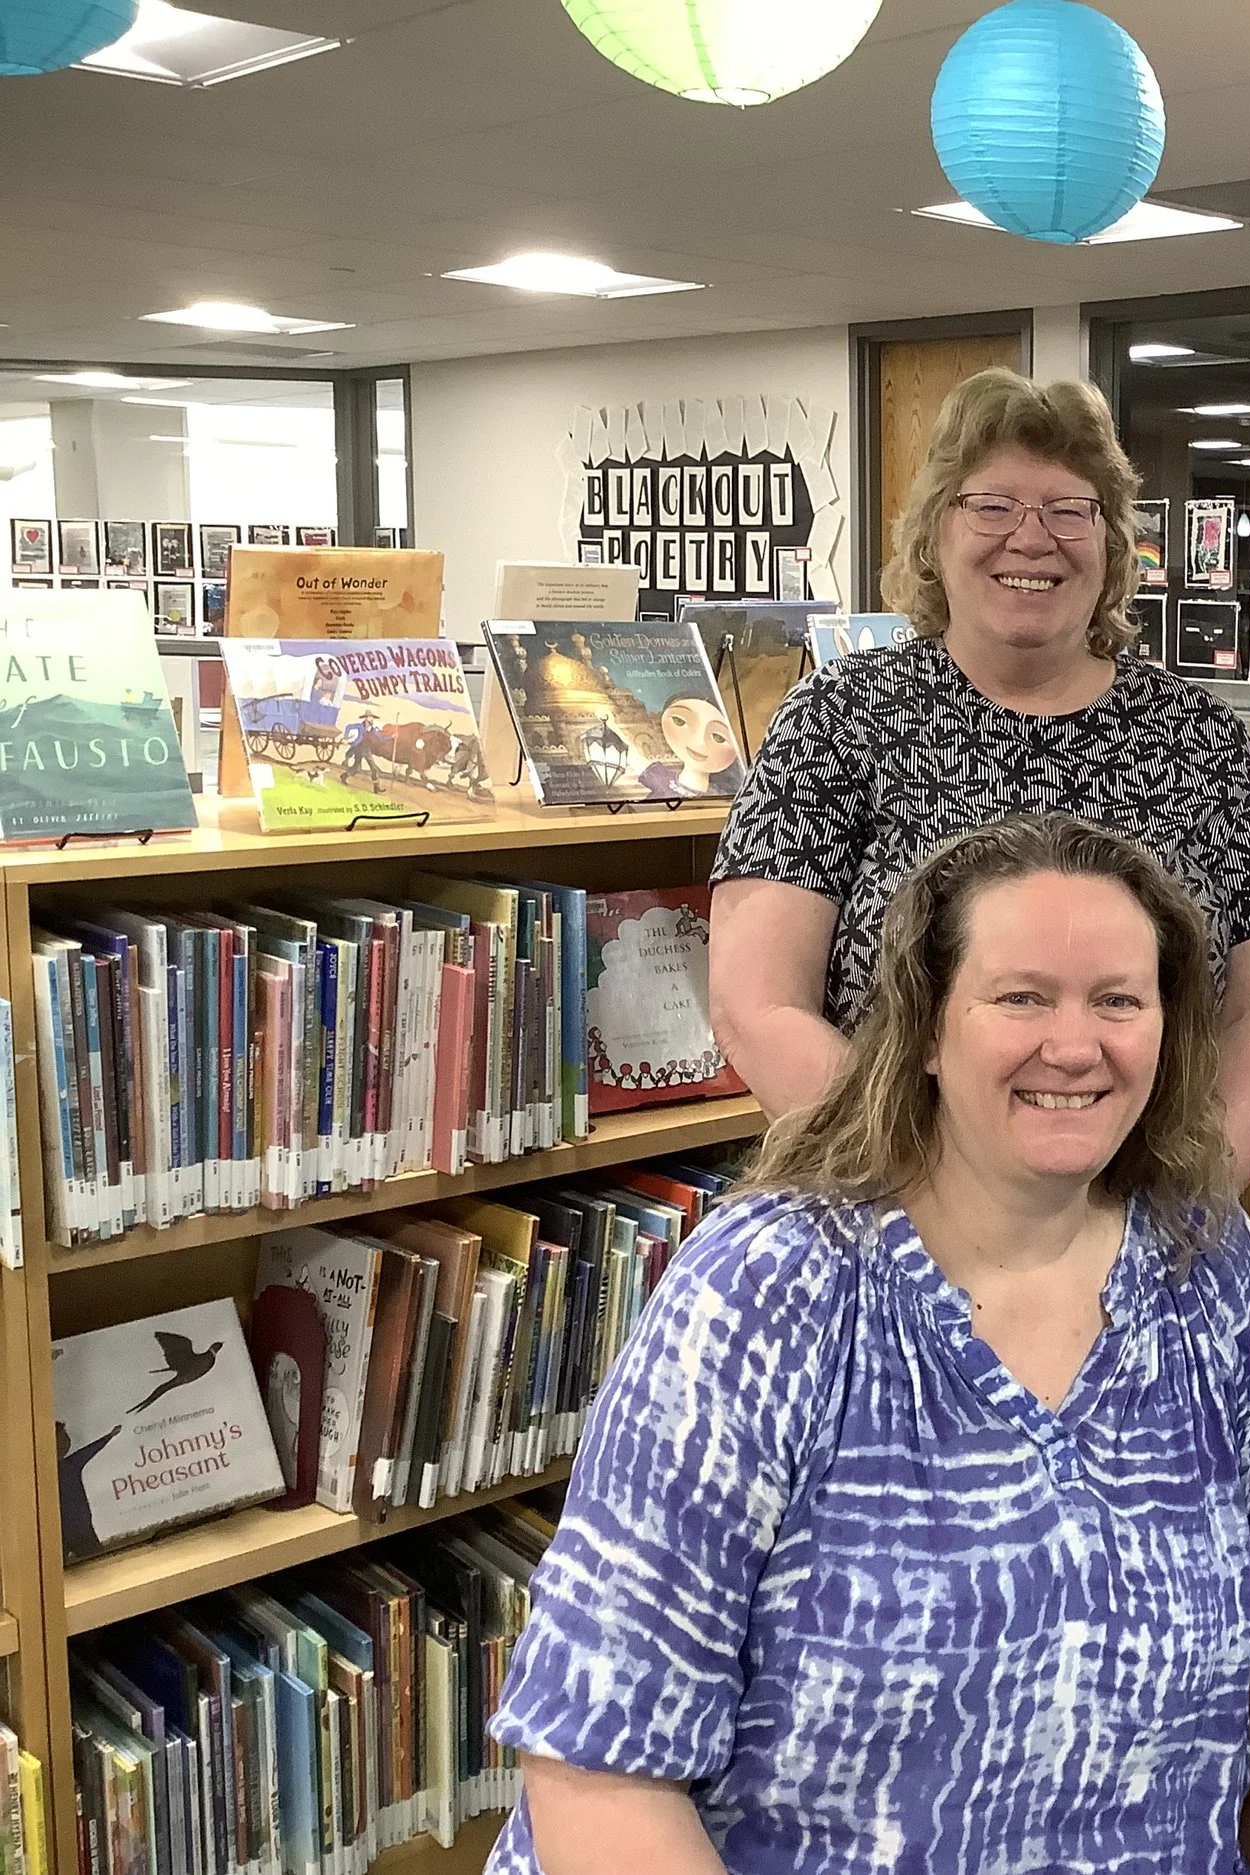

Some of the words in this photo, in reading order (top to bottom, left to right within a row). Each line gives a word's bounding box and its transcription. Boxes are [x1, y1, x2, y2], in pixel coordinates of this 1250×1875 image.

[588, 473, 789, 516] BLACKOUT
[608, 537, 767, 581] POETRY
[297, 577, 319, 589] Out
[323, 577, 336, 589] of
[342, 577, 388, 589] Wonder
[590, 633, 633, 649] Golden
[316, 649, 387, 680] COVERED
[387, 646, 459, 673] WAGONS,
[609, 648, 644, 665] Silver
[649, 650, 700, 664] Lanterns
[7, 656, 87, 682] ATE
[353, 673, 408, 700] BUMPY
[410, 670, 464, 694] TRAILS
[0, 737, 168, 771] FAUSTO
[33, 816, 66, 824] OLIVER
[299, 806, 312, 817] Kay
[644, 928, 666, 938] THE
[639, 943, 691, 958] DUCHESS
[328, 952, 336, 980] JOYCE
[655, 962, 688, 974] BAKES
[671, 983, 678, 992] A
[664, 1000, 690, 1012] CAKE
[326, 1031, 335, 1060] SLEEPY
[336, 1036, 345, 1070] FLIGHT
[326, 1063, 334, 1083] TIME
[337, 1073, 345, 1110] SCHOOL
[95, 1109, 103, 1131] Found
[329, 1272, 335, 1281] A
[133, 1419, 167, 1436] Cheryl
[134, 1421, 242, 1468] Johnny's
[111, 1451, 230, 1500] Pheasant
